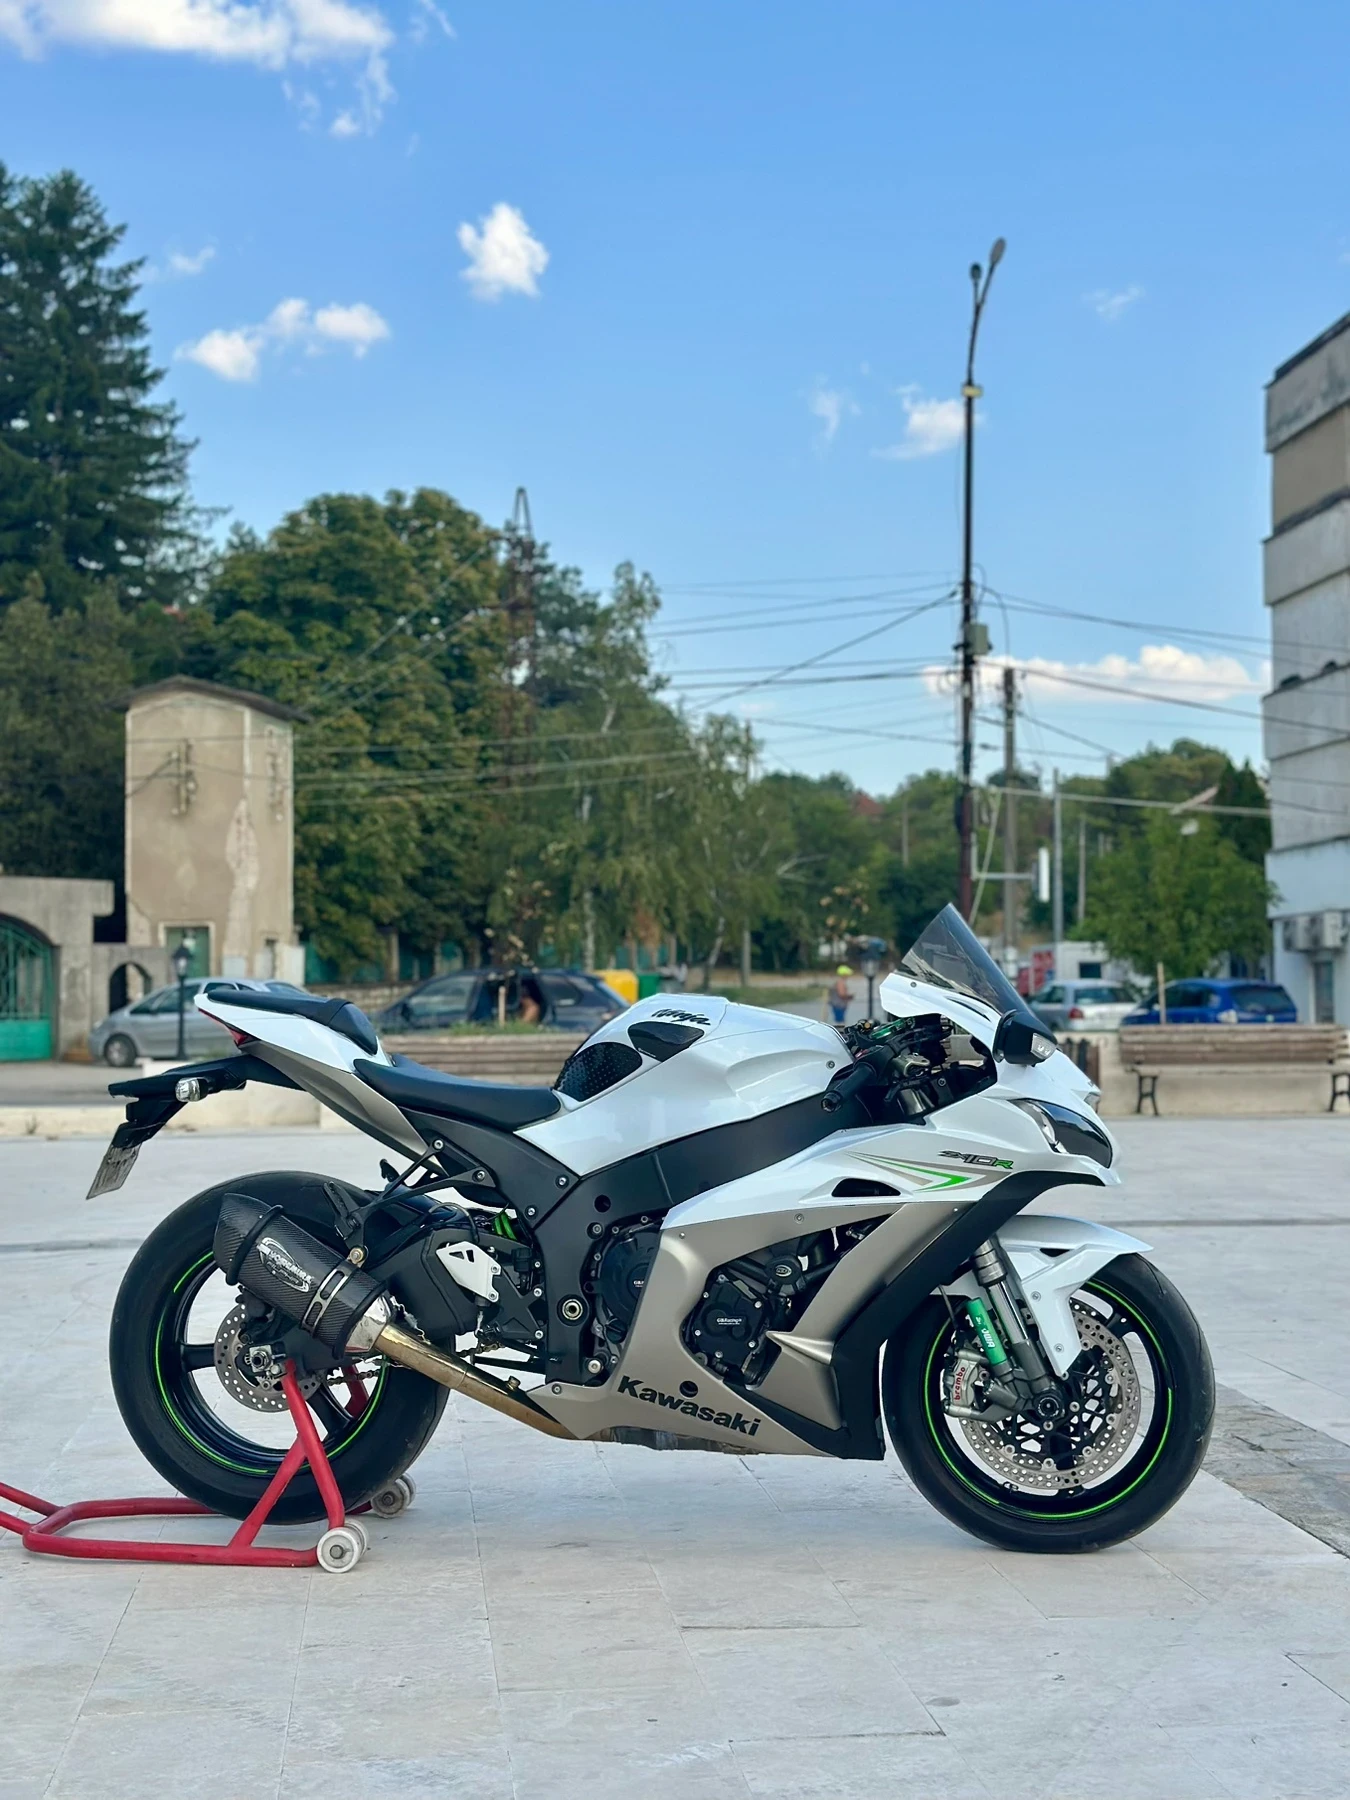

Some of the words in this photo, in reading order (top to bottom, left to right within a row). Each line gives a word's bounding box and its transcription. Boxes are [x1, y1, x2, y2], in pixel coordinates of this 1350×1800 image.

[651, 1008, 711, 1025] Ninja
[954, 1366, 966, 1401] brembo
[617, 1375, 762, 1437] Kawasaki
